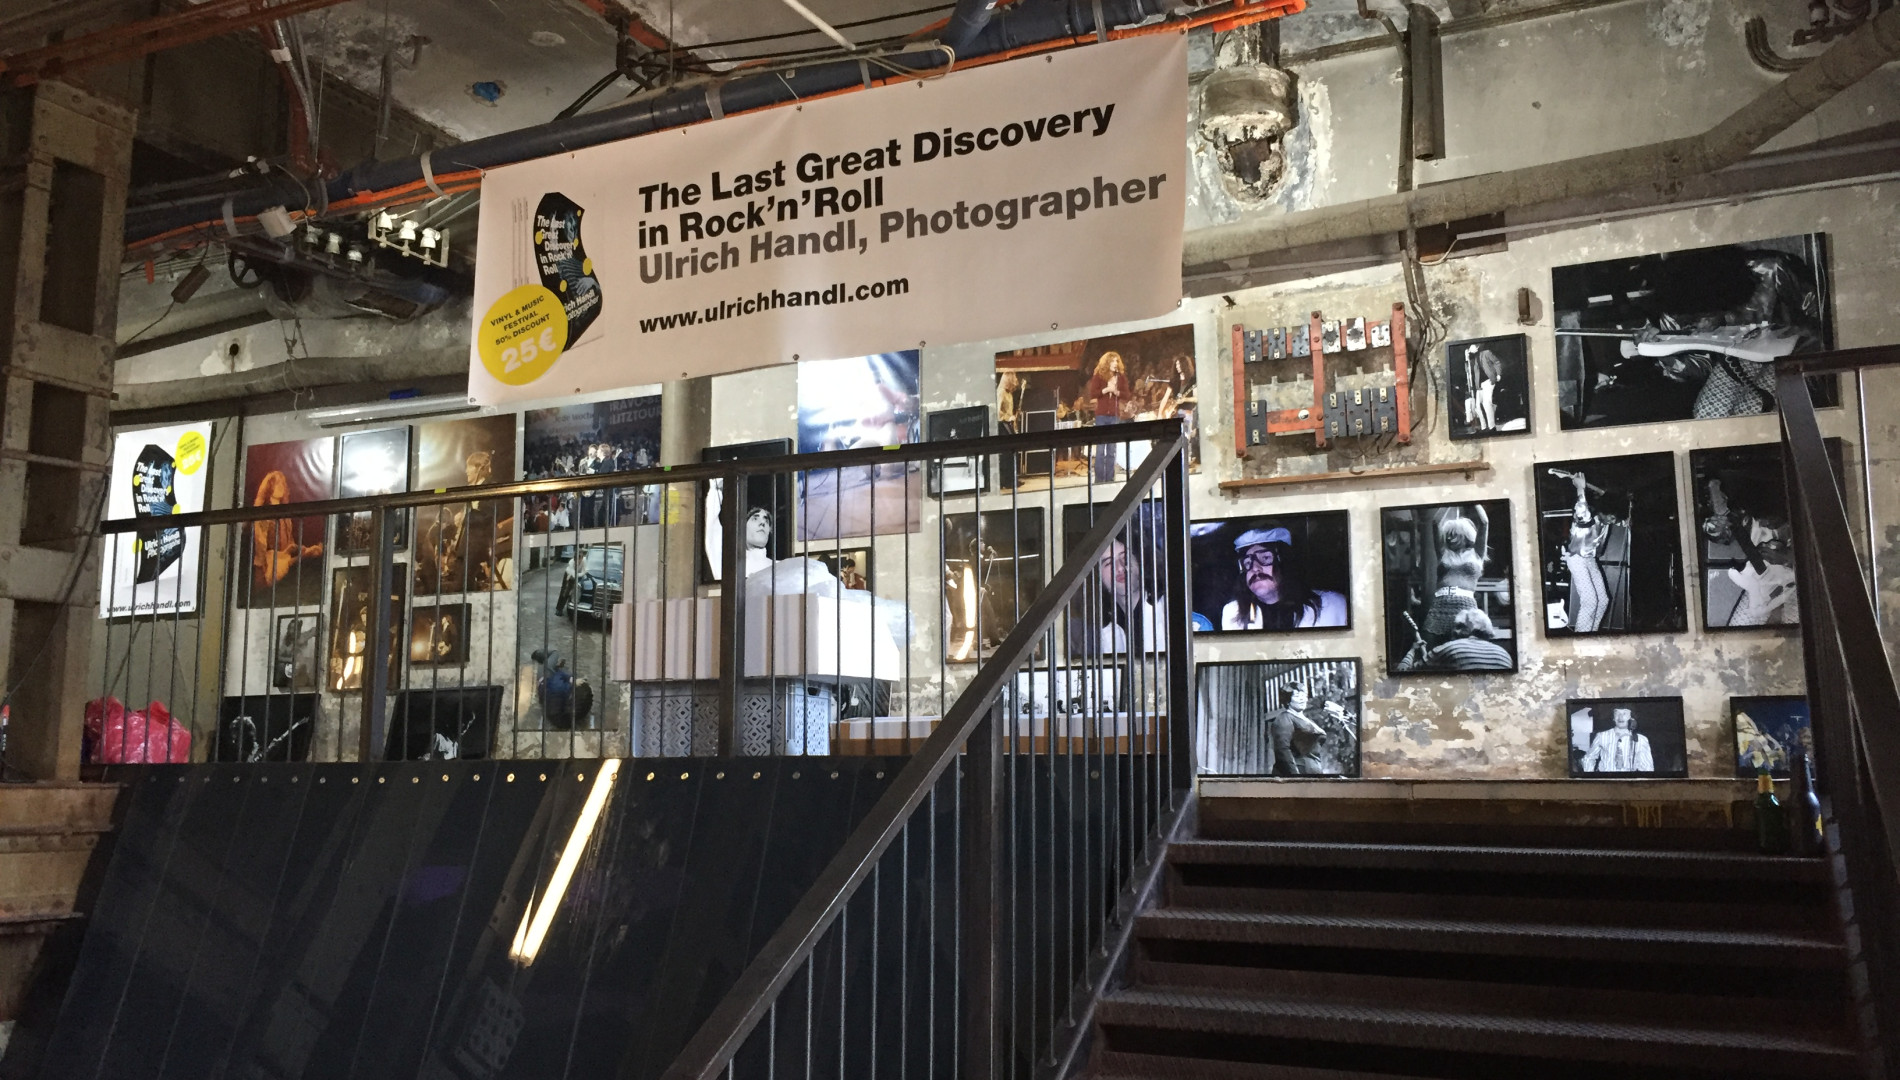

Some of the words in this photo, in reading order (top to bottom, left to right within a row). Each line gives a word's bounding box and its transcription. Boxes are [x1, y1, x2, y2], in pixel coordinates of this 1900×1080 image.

[639, 182, 701, 213] The
[711, 160, 786, 201] Last
[796, 139, 901, 183] Great
[913, 103, 1115, 163] Discovery
[537, 215, 549, 228] The
[639, 221, 668, 249] in
[680, 176, 883, 242] Rock'n'Roll
[640, 242, 739, 284] Ulrich
[750, 219, 867, 264] Handl,
[880, 173, 1166, 243] Photographer
[540, 254, 548, 264] in
[544, 240, 577, 252] Discovery
[543, 264, 559, 275] Roll
[576, 289, 596, 305] Handl
[640, 277, 909, 333] www.ulrichhandl.com
[490, 312, 513, 327] VINYL
[515, 308, 521, 316] &
[521, 295, 545, 312] MUSIC
[503, 310, 539, 331] FESTIVAL
[495, 334, 512, 346] 50%
[512, 313, 550, 338] DISCOUNT
[501, 326, 557, 374] 25€
[137, 462, 148, 473] The
